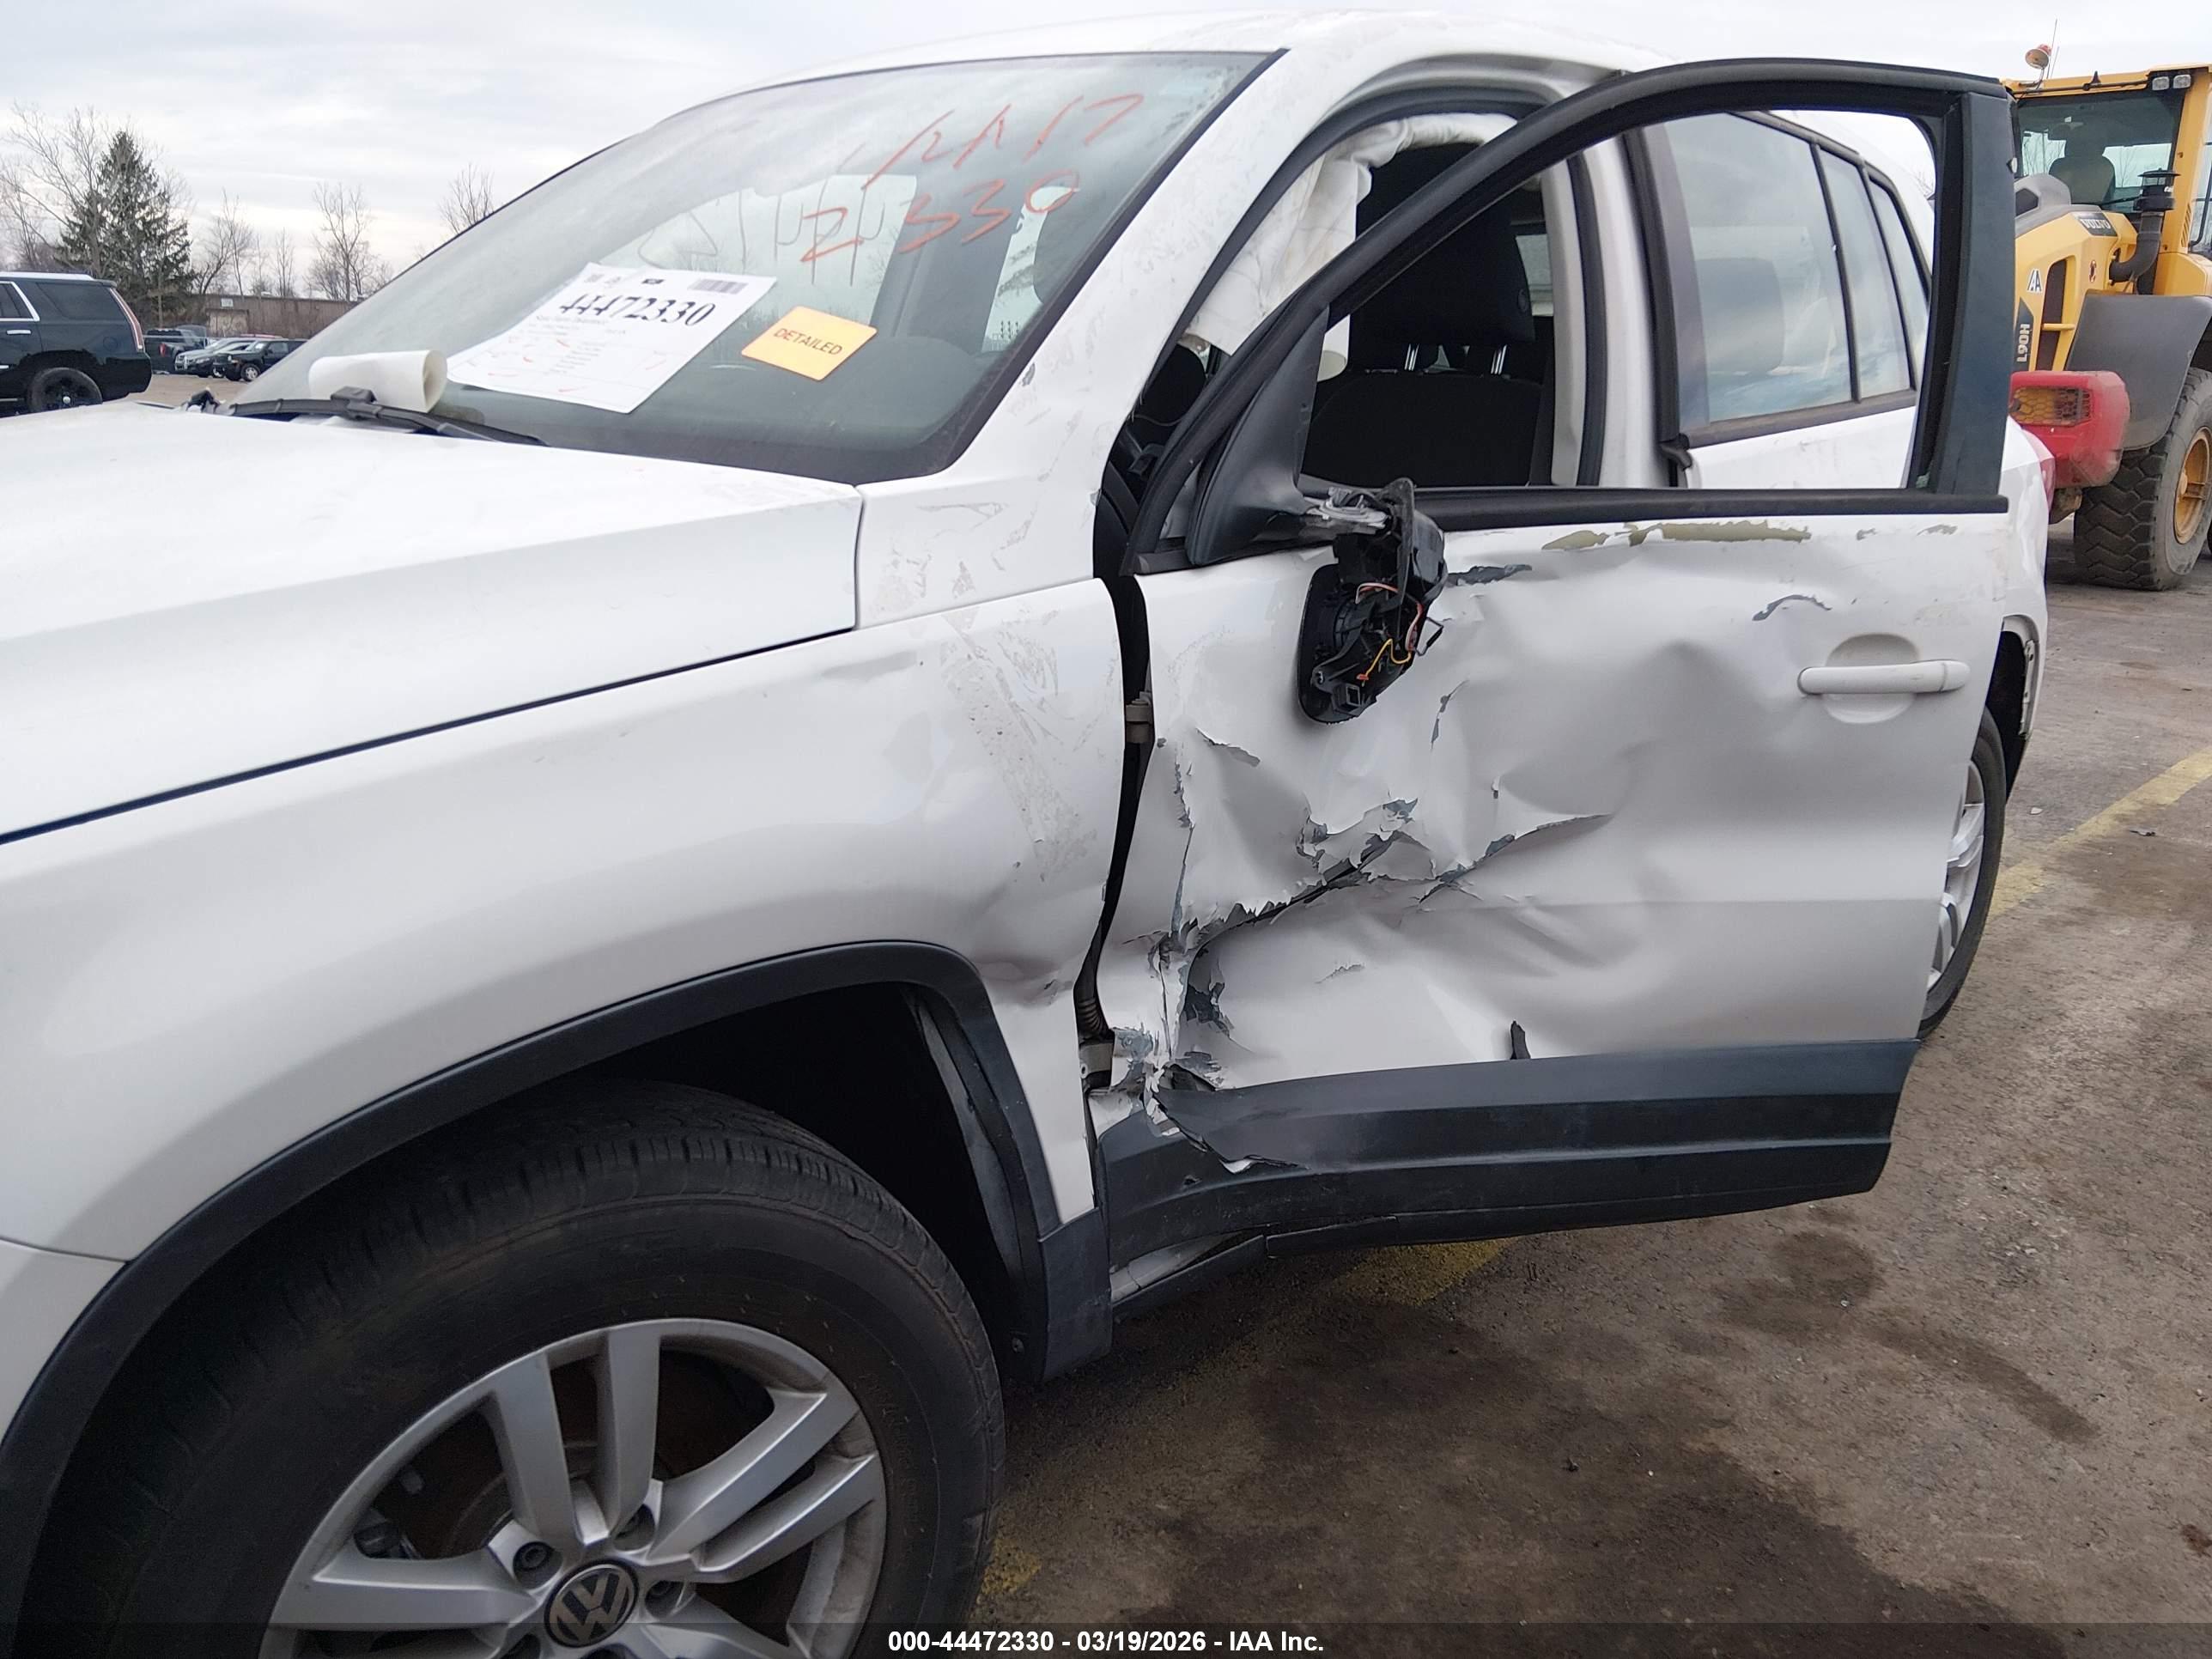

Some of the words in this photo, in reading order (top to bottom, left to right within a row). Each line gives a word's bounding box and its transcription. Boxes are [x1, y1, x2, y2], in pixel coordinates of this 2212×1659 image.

[559, 293, 716, 326] 44472330
[774, 328, 843, 356] DETAILED
[2017, 324, 2031, 362] L90H
[550, 1564, 635, 1645] VW
